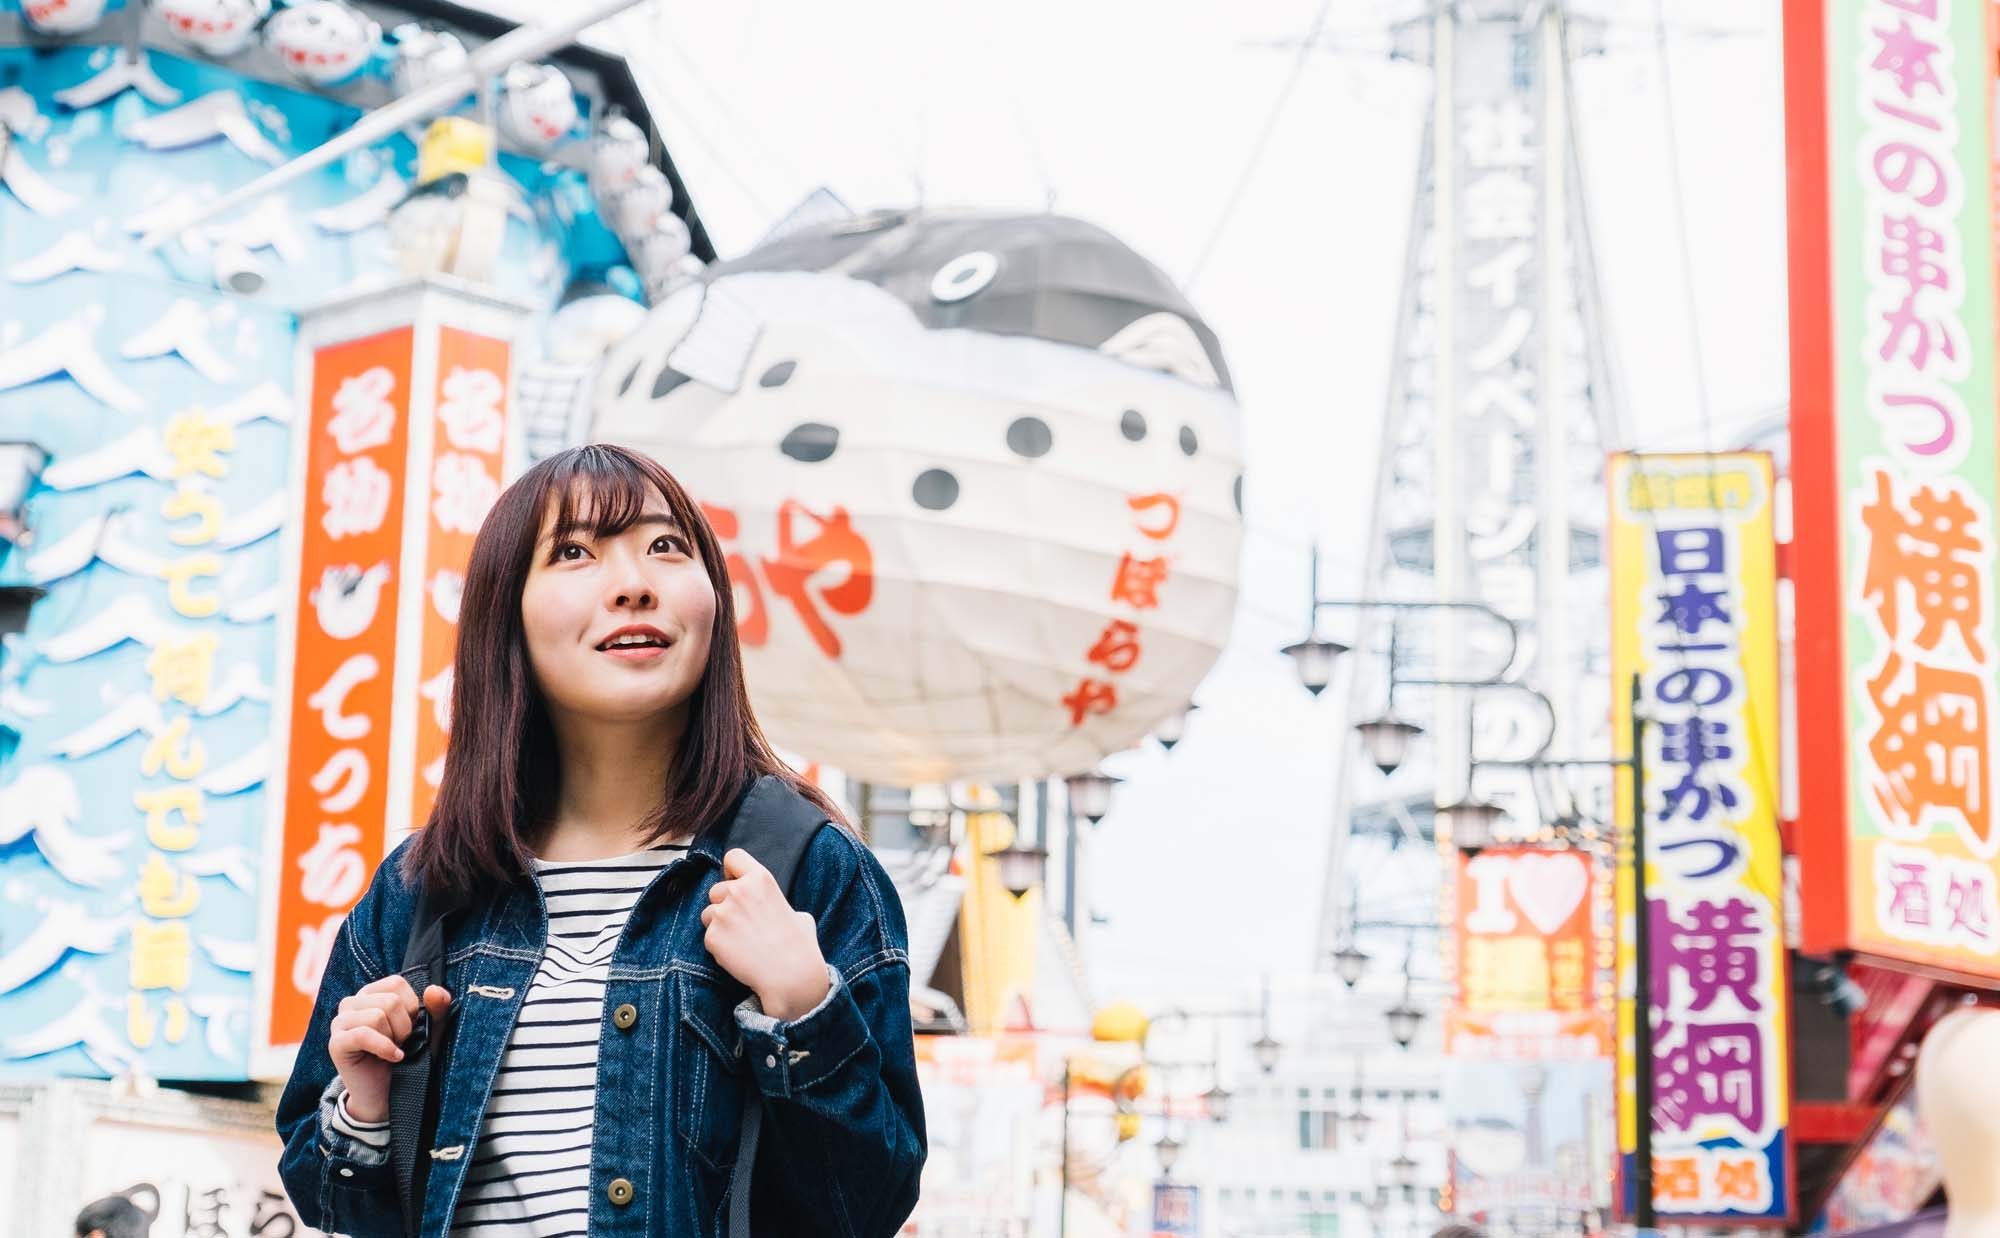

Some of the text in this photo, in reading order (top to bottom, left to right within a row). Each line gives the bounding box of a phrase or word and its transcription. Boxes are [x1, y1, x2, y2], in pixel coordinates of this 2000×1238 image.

[1870, 0, 1955, 456] 本一の串かつ
[1861, 469, 1991, 844] 横綱
